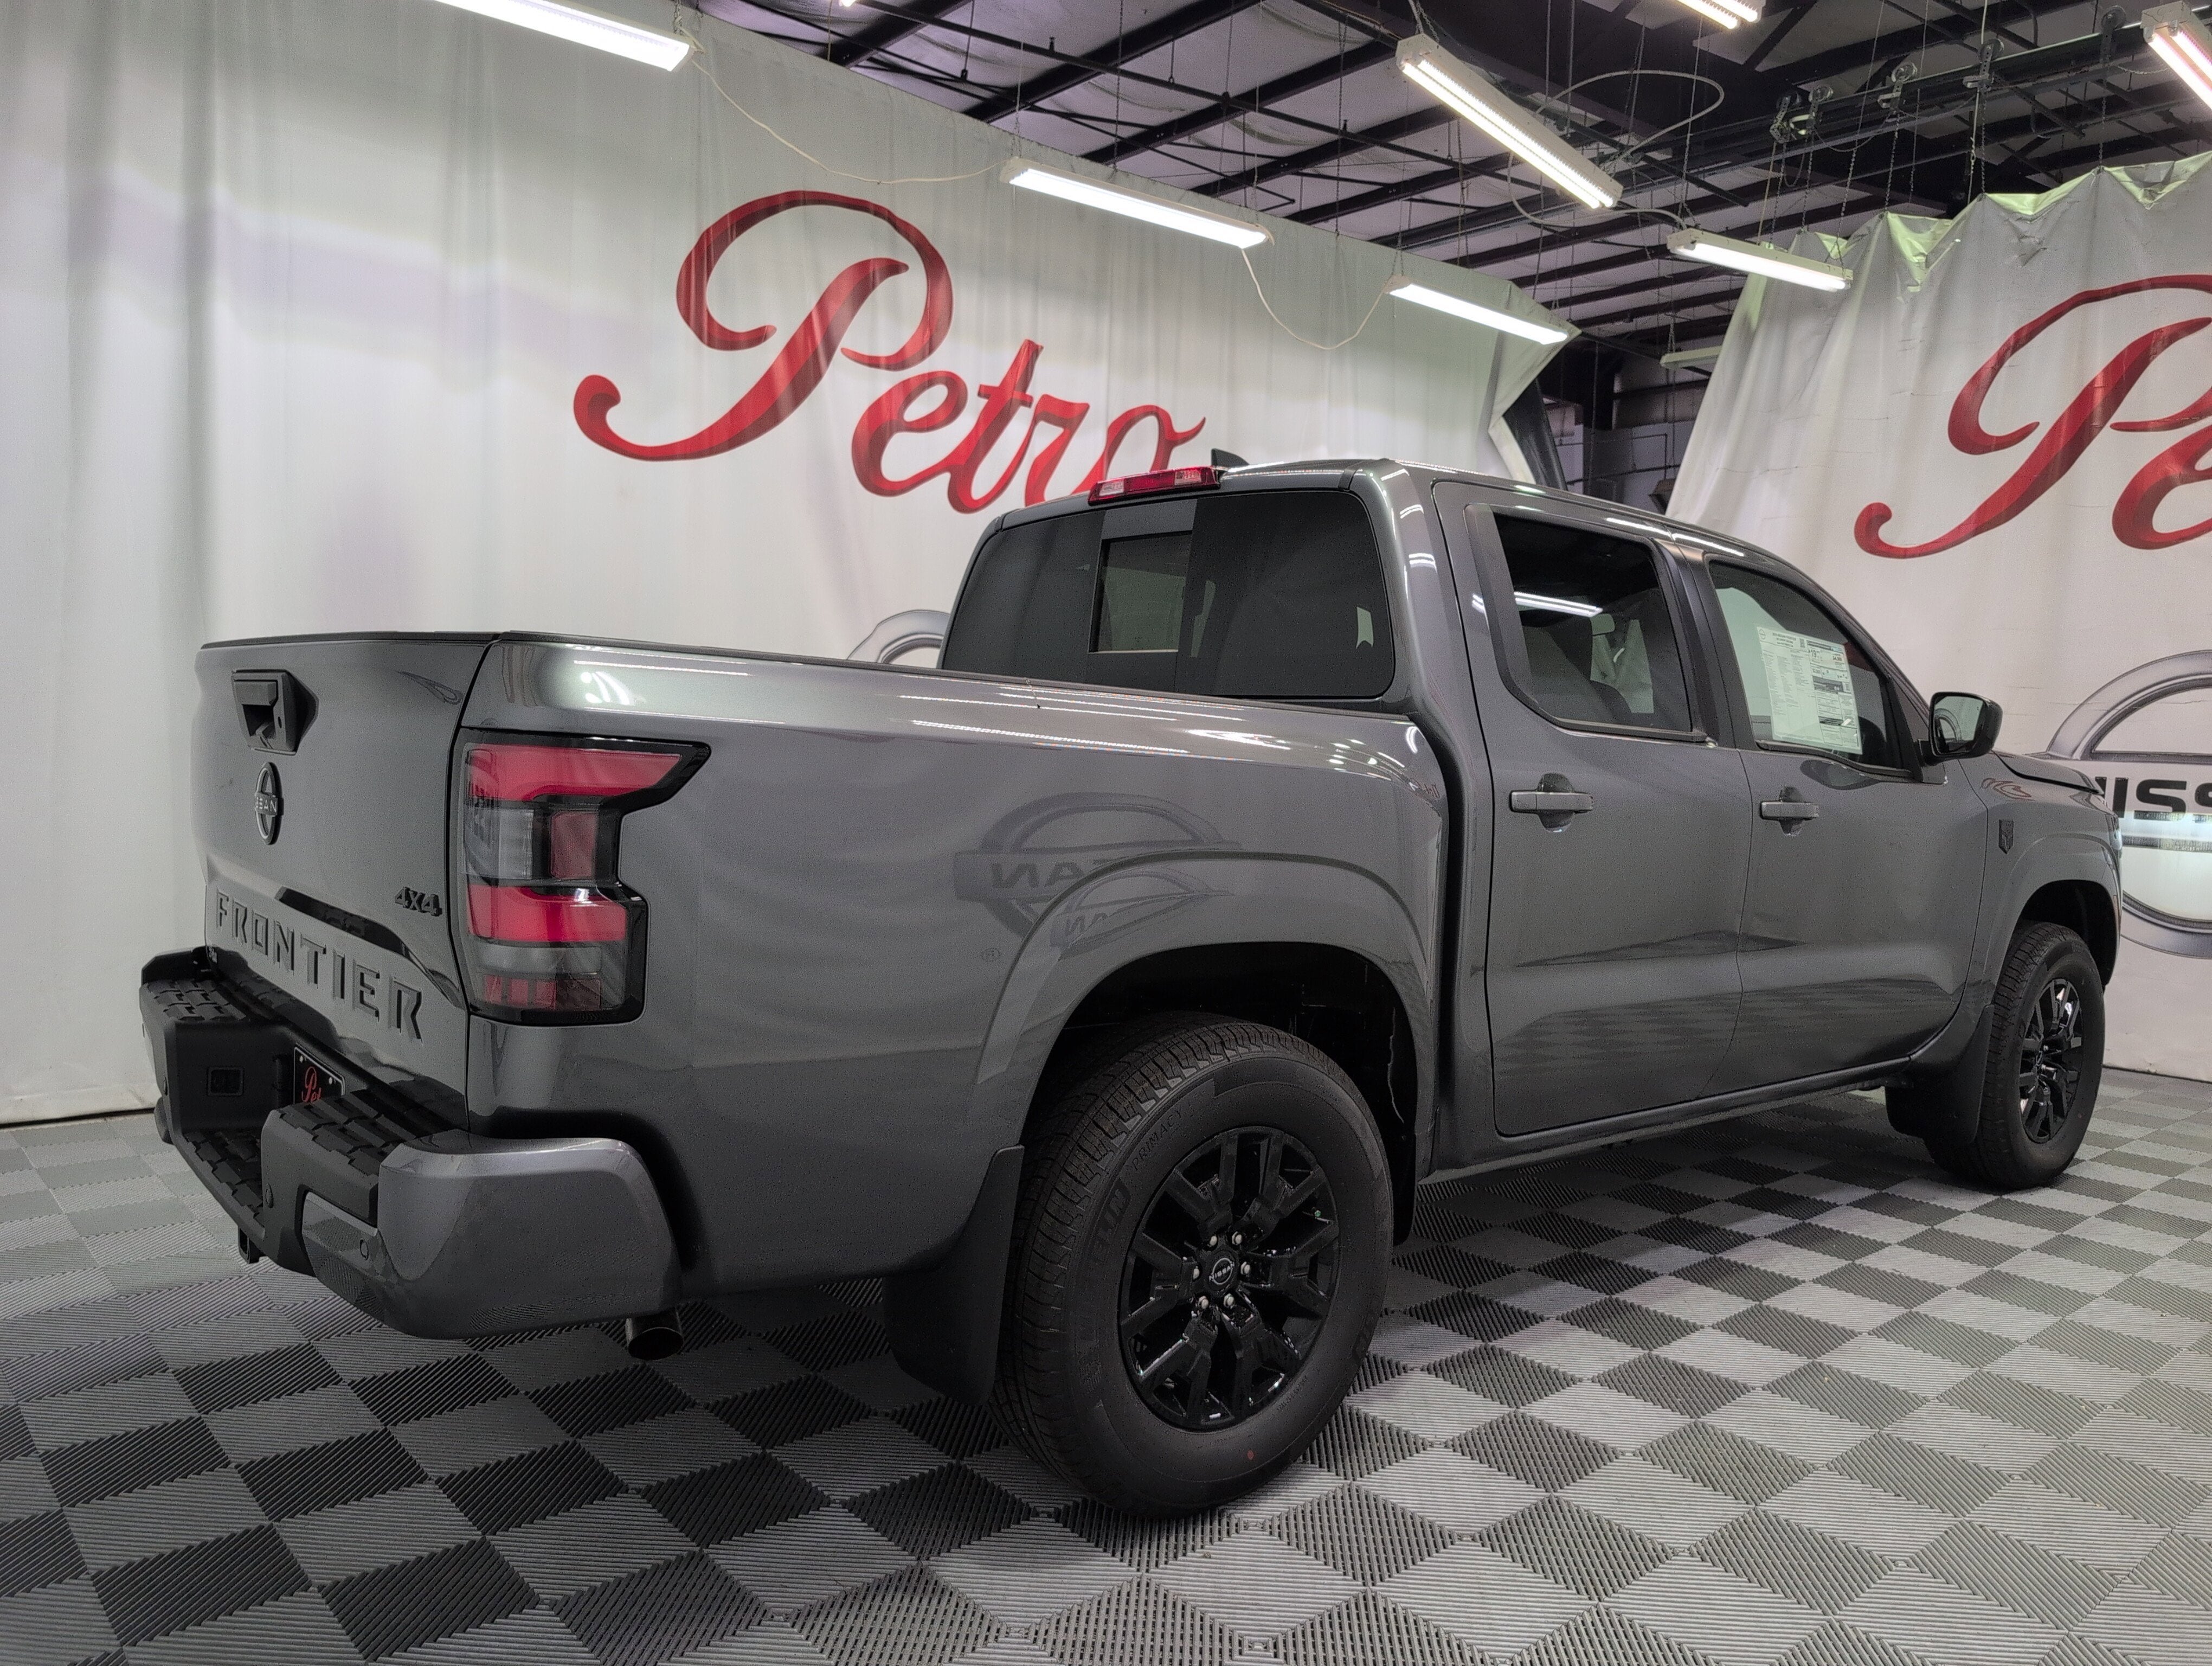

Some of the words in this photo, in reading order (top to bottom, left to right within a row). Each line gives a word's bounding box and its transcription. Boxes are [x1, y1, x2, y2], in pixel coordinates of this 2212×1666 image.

[573, 190, 1206, 514] Petro
[216, 891, 425, 1045] FRONTIER
[1131, 1107, 1183, 1171] PRIMACY
[1208, 1260, 1235, 1283] NISSAN
